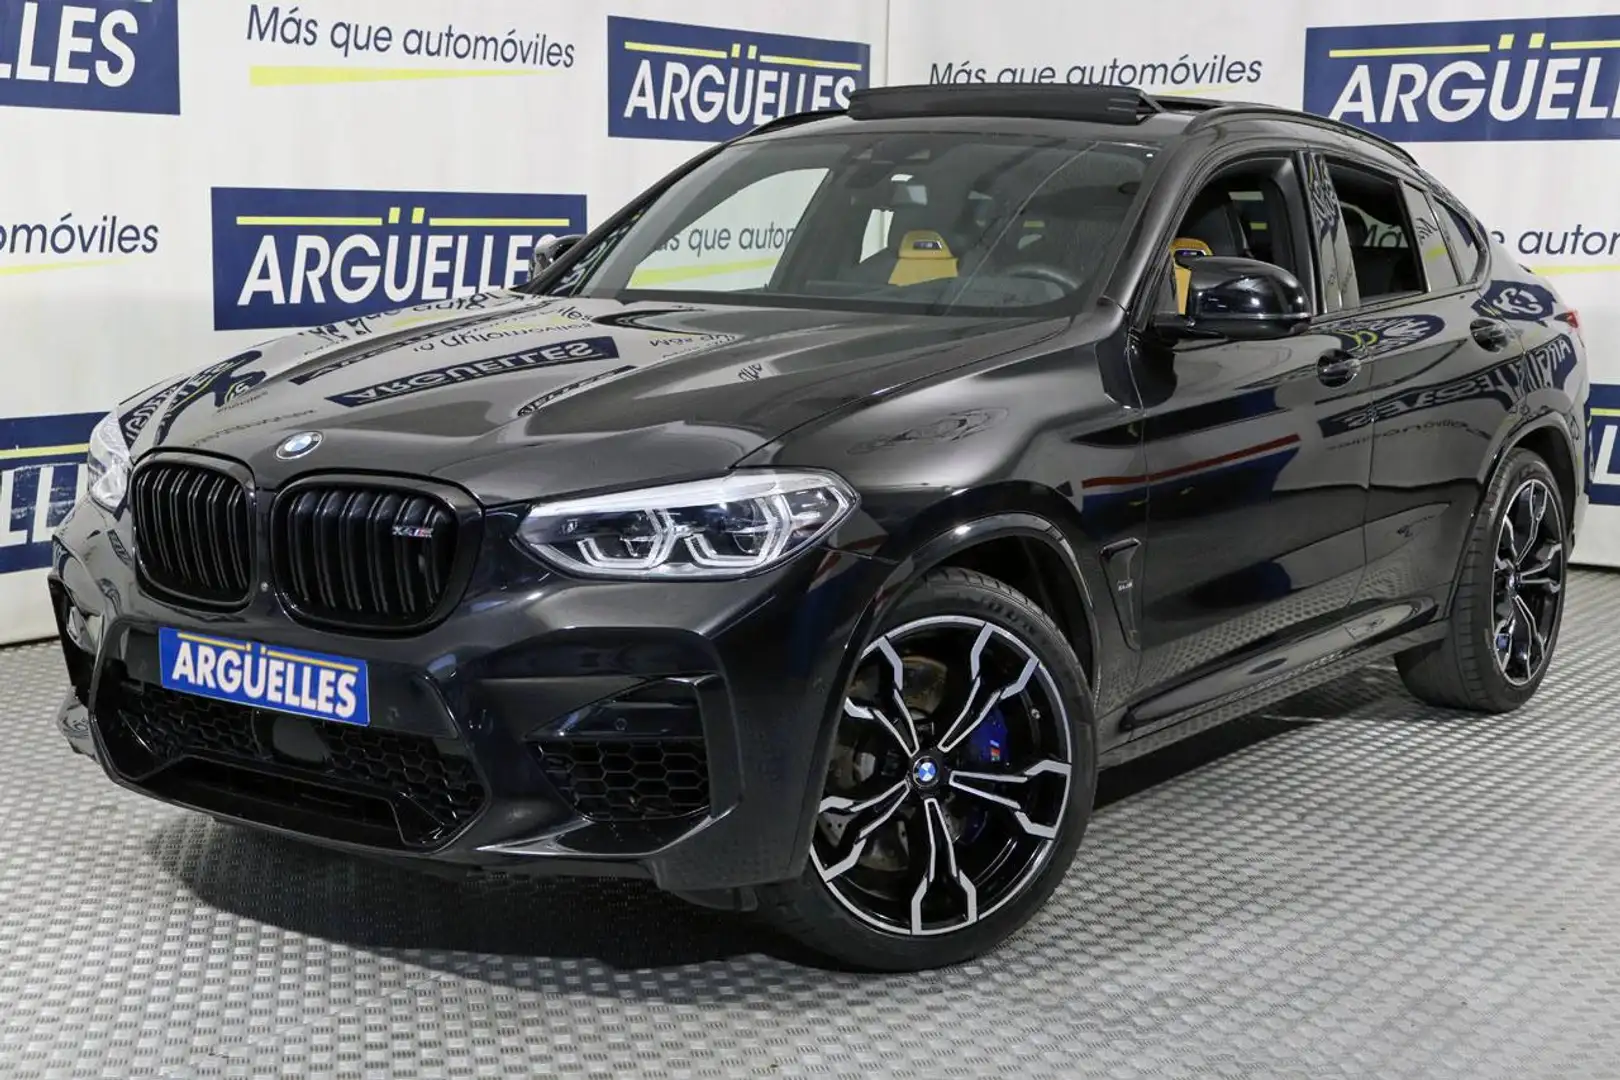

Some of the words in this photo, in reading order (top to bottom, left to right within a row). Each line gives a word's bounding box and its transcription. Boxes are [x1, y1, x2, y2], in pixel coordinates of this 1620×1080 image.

[247, 4, 318, 46] Más
[330, 21, 393, 58] que
[403, 24, 575, 68] automóviles
[1066, 54, 1262, 86] automóviles
[1327, 33, 1620, 122] ARGÜEL
[237, 207, 557, 305] ARGÜELLE
[688, 226, 732, 258] que
[172, 642, 357, 719] ARGÜELLES
